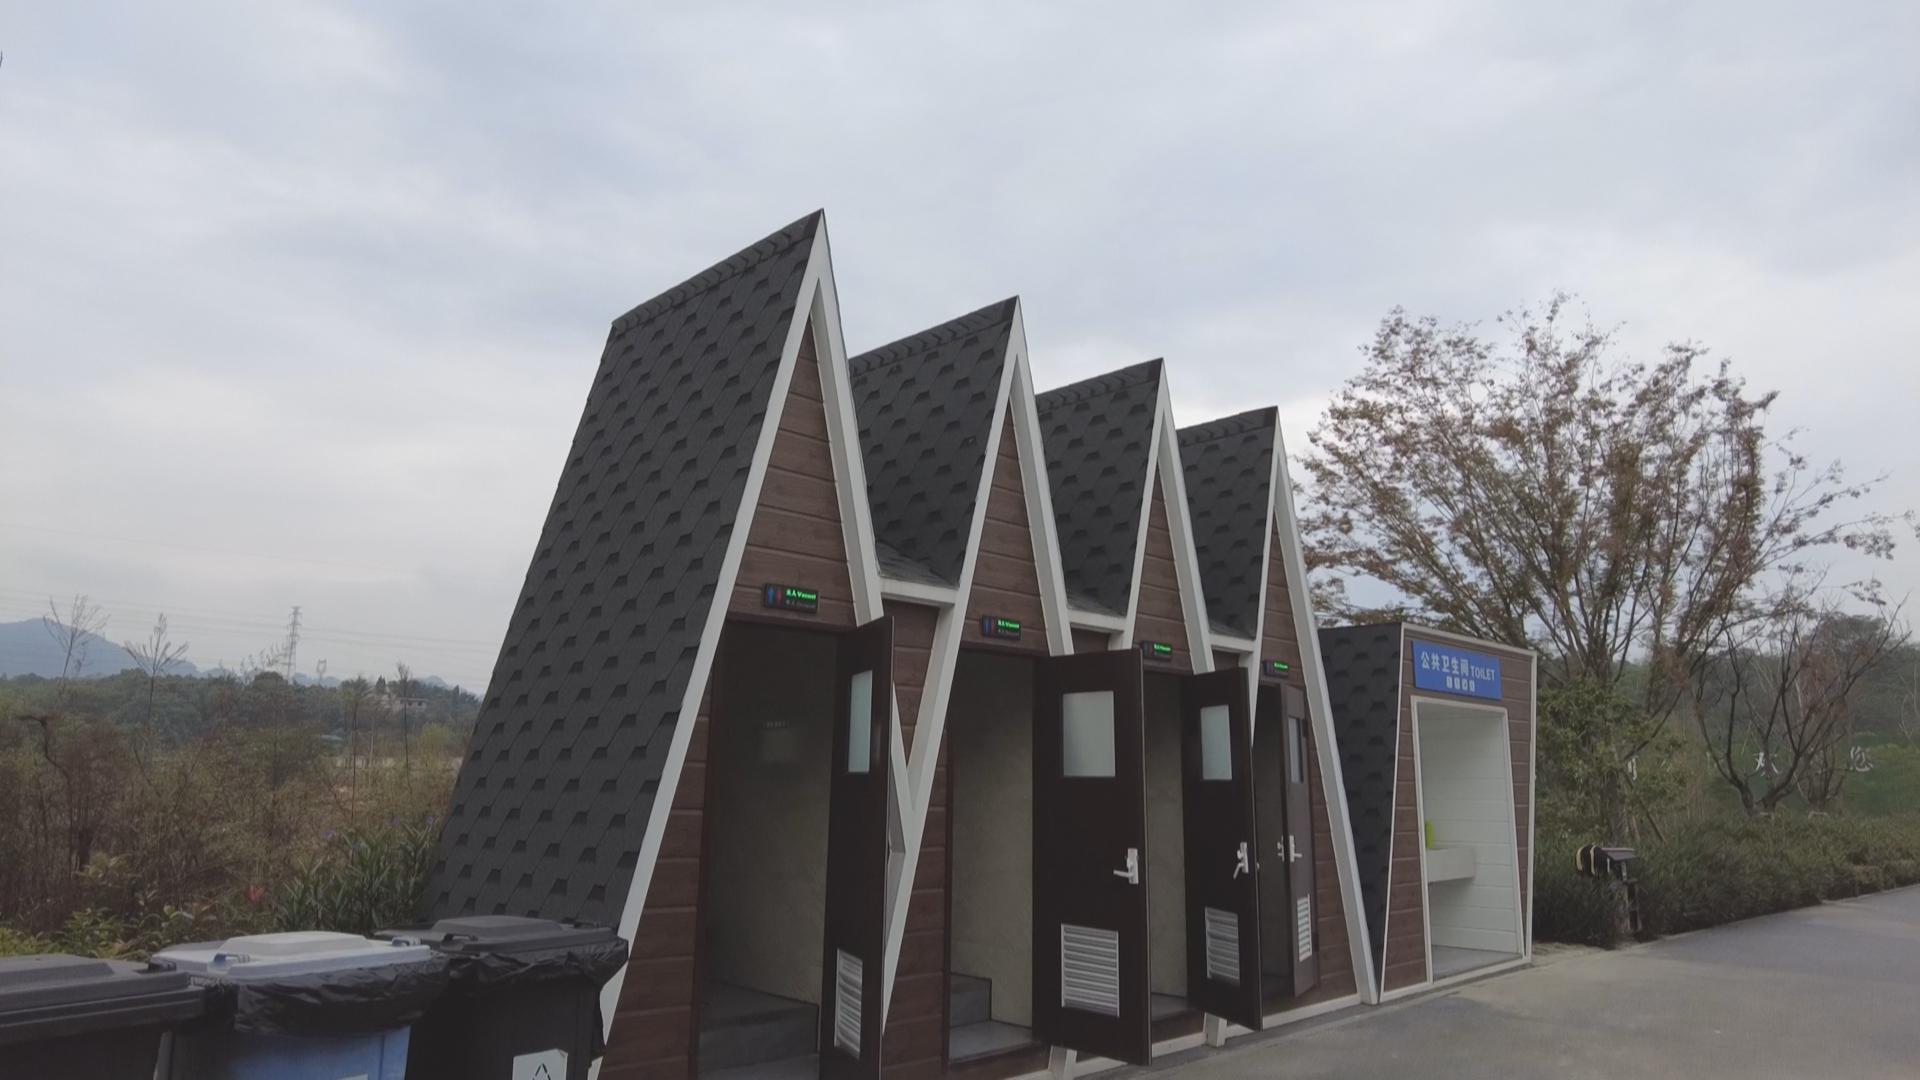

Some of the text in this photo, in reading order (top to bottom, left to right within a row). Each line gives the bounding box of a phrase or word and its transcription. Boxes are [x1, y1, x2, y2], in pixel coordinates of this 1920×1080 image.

[1421, 651, 1495, 681] 公共卫生间 TOILET
